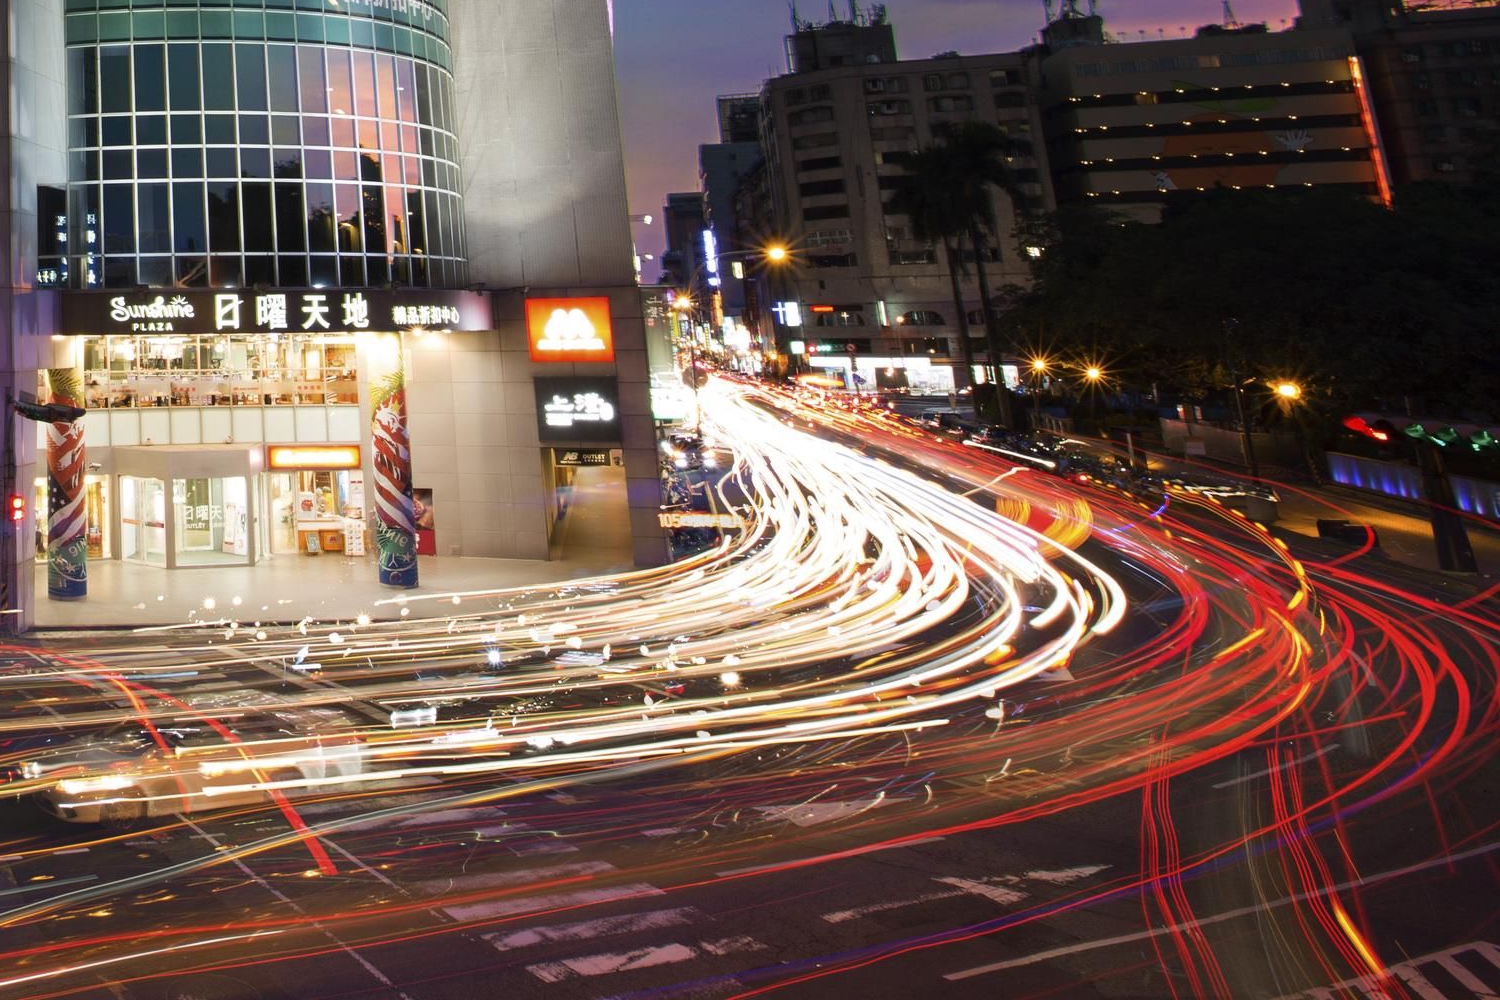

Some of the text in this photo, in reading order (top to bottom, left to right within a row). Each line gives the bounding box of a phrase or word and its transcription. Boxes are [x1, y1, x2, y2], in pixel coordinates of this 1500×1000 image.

[110, 295, 195, 322] Sunshine
[214, 293, 370, 331] 日曜天地
[132, 322, 174, 332] PLAZA
